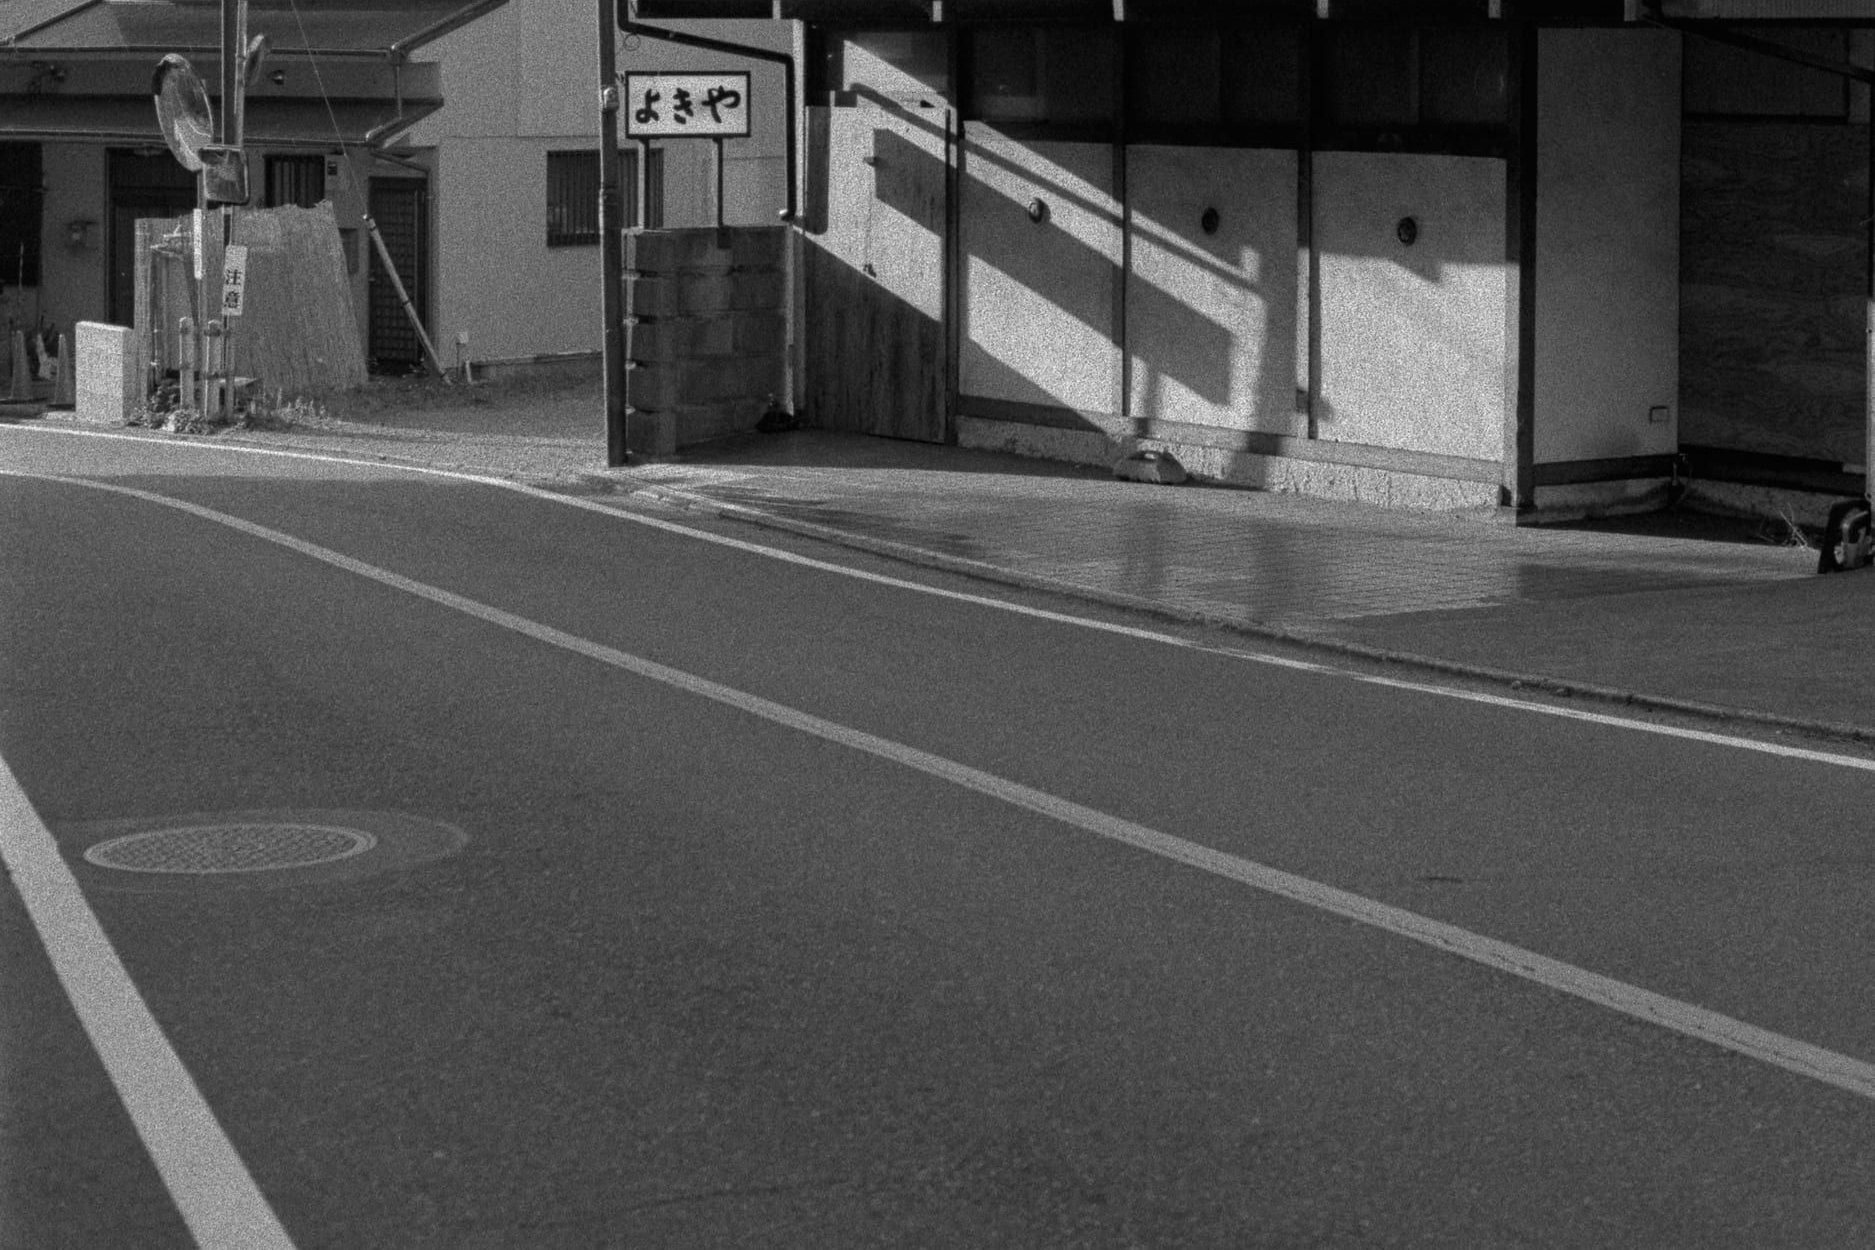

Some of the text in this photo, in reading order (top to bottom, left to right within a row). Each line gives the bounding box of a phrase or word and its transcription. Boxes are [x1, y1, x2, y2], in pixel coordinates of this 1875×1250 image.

[635, 85, 741, 124] よきや
[224, 269, 242, 308] 注意
